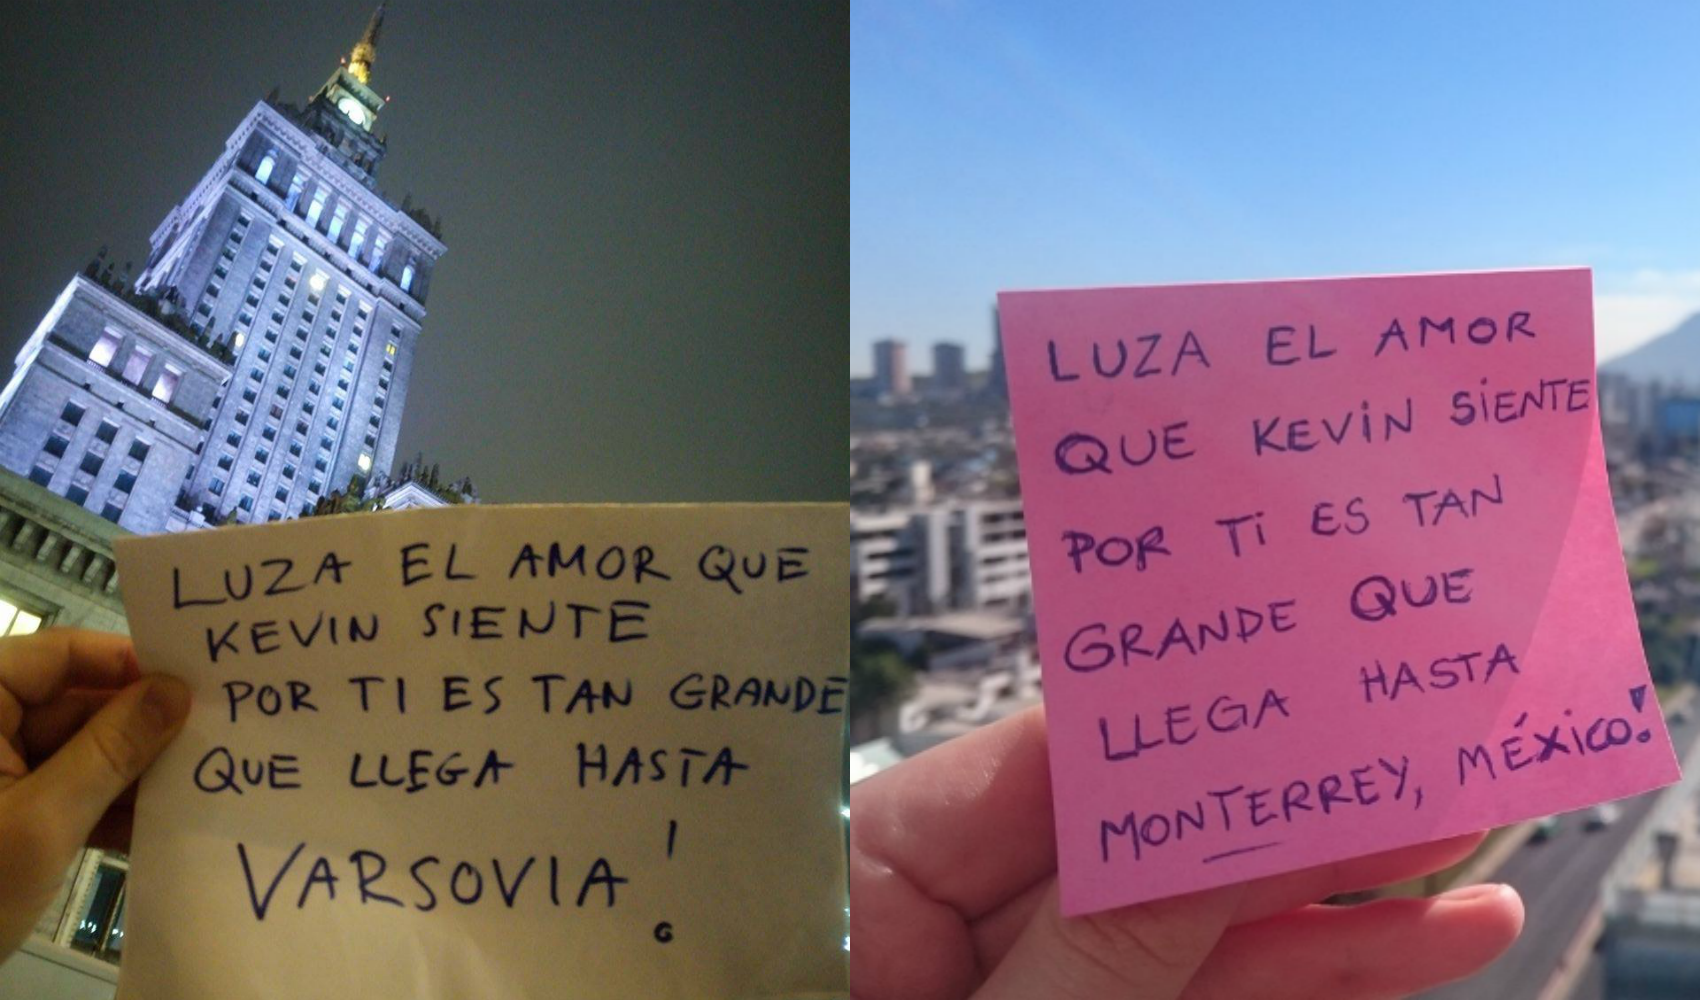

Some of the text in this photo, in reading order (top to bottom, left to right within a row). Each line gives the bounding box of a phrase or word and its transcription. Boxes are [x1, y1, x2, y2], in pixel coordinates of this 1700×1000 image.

[1047, 311, 1537, 382] LUZA EL AMOR
[1053, 422, 1197, 476] QUE
[1063, 526, 1172, 575] POR
[1310, 497, 1372, 538] ES
[1403, 473, 1505, 530] TAN
[172, 542, 813, 610] LUZA EL AMOR QUE
[205, 600, 653, 663] KEVIN SIENTE
[1063, 567, 1476, 674] GRANDE QUE
[222, 673, 849, 722] POR TI ES TAN GRANDE
[1098, 642, 1523, 764] LLEGA HASTA
[192, 741, 751, 797] QUE LLEGA HASTA
